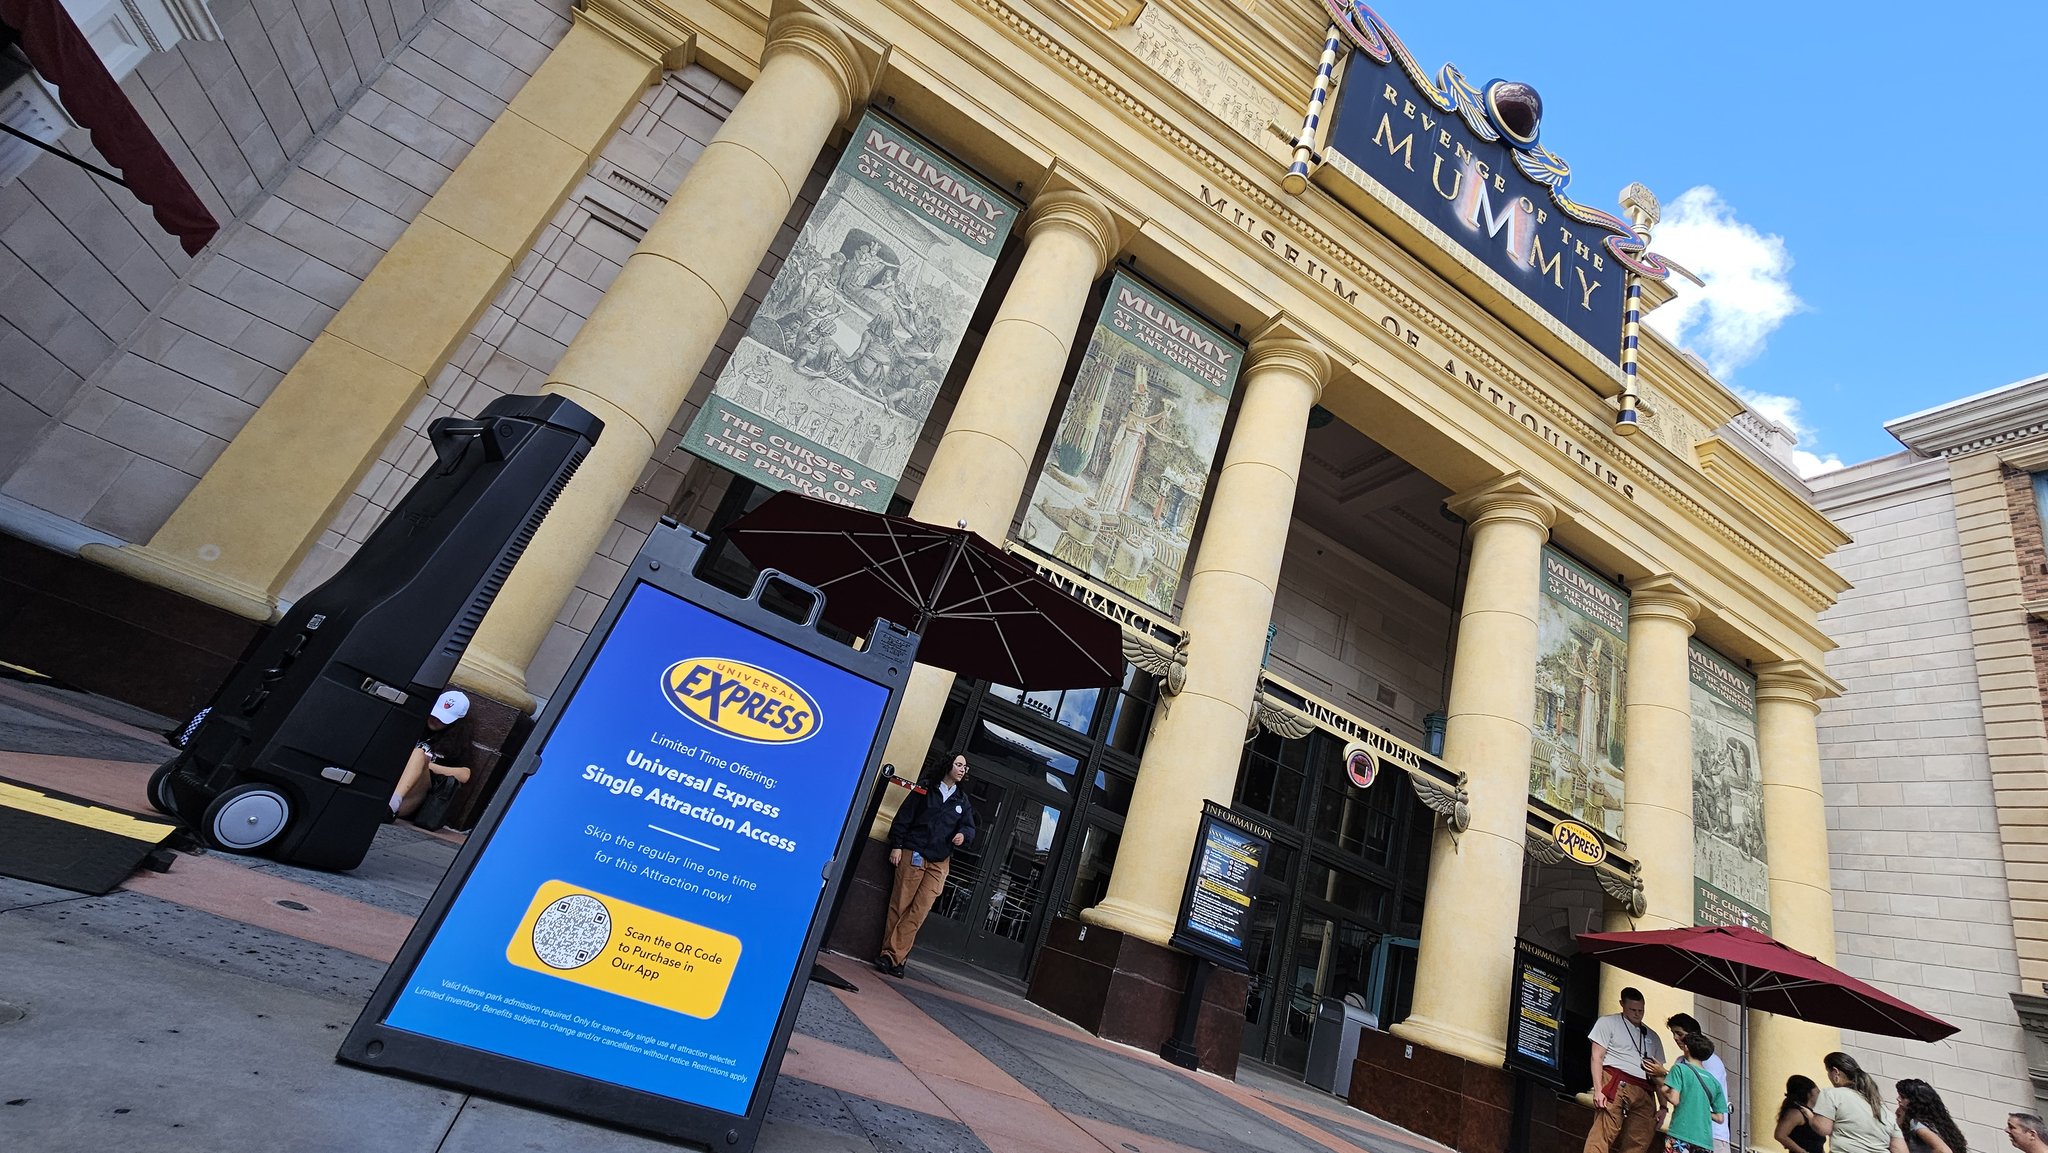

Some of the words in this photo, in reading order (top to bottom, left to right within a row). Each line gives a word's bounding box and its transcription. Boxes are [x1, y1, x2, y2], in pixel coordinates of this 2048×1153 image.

[857, 163, 882, 179] OF
[883, 180, 988, 245] ANTIQUITIES
[858, 153, 884, 169] AT
[887, 167, 919, 193] THE
[922, 190, 996, 240] MUSEUM
[865, 129, 1005, 221] MUMMY
[1384, 84, 1505, 193] REVENGE
[1519, 196, 1547, 224] OF
[1560, 226, 1604, 272] THE
[1372, 113, 1601, 311] MUMMY
[1113, 309, 1134, 323] AT
[1136, 320, 1164, 341] THE
[1166, 339, 1228, 382] MUSEUM
[1113, 318, 1133, 332] OF
[1134, 331, 1222, 388] ANTIQUITIES
[1118, 287, 1233, 365] MUMMY
[1199, 183, 1359, 306] MUSEUM
[1381, 315, 1420, 348] OF
[1443, 358, 1635, 502] ANTIQUITIES
[704, 433, 750, 463] THE
[719, 409, 764, 438] THE
[768, 434, 856, 481] CURSES
[860, 478, 878, 494] &
[721, 427, 828, 483] LEGENDS
[833, 480, 863, 497] OF
[1035, 564, 1158, 639] ENTRANCE
[1547, 557, 1623, 612] MUMMY
[1547, 576, 1561, 587] AT
[1562, 584, 1581, 601] THE
[1582, 597, 1624, 628] MUSEUM
[1549, 584, 1563, 595] OF
[1563, 594, 1622, 633] ANTIQUITIES
[674, 664, 810, 735] EXPRESS
[716, 663, 796, 702] UNIVERSAL
[1688, 646, 1751, 695] MUMMY
[1692, 672, 1704, 682] OF
[1703, 671, 1719, 686] THE
[650, 731, 698, 758] Limited
[700, 748, 728, 769] Time
[729, 761, 778, 789] Offering:
[1302, 699, 1363, 741] SINGLE
[1367, 732, 1421, 770] RIDERS
[581, 764, 645, 798] Single
[644, 787, 736, 831] Attraction
[736, 820, 797, 853] Access
[626, 749, 712, 793] Universal
[712, 784, 781, 819] Express
[1205, 803, 1273, 840] INFORMATION
[1558, 826, 1600, 859] EXPRESS
[584, 824, 612, 844] Skip
[615, 834, 635, 850] the
[637, 844, 681, 866] regular
[683, 854, 705, 873] line
[707, 866, 730, 882] one
[732, 874, 758, 891] time
[594, 850, 613, 868] for
[615, 858, 638, 874] this
[639, 866, 699, 894] Attraction
[701, 883, 733, 904] now!
[1699, 909, 1718, 925] THE
[1700, 887, 1719, 904] THE
[1760, 920, 1769, 931] &
[1704, 901, 1744, 926] LEGEND
[611, 957, 634, 972] Our
[634, 964, 660, 981] App
[618, 942, 631, 954] to
[632, 942, 682, 970] Purchase
[684, 960, 694, 973] in
[624, 926, 652, 944] Scan
[653, 935, 672, 950] the
[674, 941, 693, 956] QR
[694, 947, 723, 965] Code
[1519, 941, 1569, 968] INFORMATION
[414, 986, 445, 1001] Limited
[445, 995, 482, 1012] inventory.
[482, 1004, 513, 1019] Benefits
[513, 1013, 541, 1027] subject
[541, 1020, 549, 1029] to
[549, 1023, 577, 1037] change
[576, 1028, 601, 1043] and/or
[601, 1036, 643, 1054] cancellation
[643, 1045, 669, 1061] without
[669, 1055, 691, 1067] notice.
[691, 1060, 729, 1078] Restrictions
[729, 1072, 748, 1084] apply.
[441, 978, 461, 991] Valid
[461, 984, 485, 998] theme
[485, 991, 502, 1003] park
[503, 995, 541, 1012] admission
[541, 1008, 572, 1022] required.
[573, 1015, 591, 1027] Only
[590, 1019, 601, 1029] for
[601, 1023, 636, 1040] same-day
[636, 1032, 657, 1046] single
[657, 1039, 669, 1048] use
[669, 1042, 678, 1051] at
[677, 1044, 709, 1059] attraction
[709, 1053, 737, 1067] selected.
